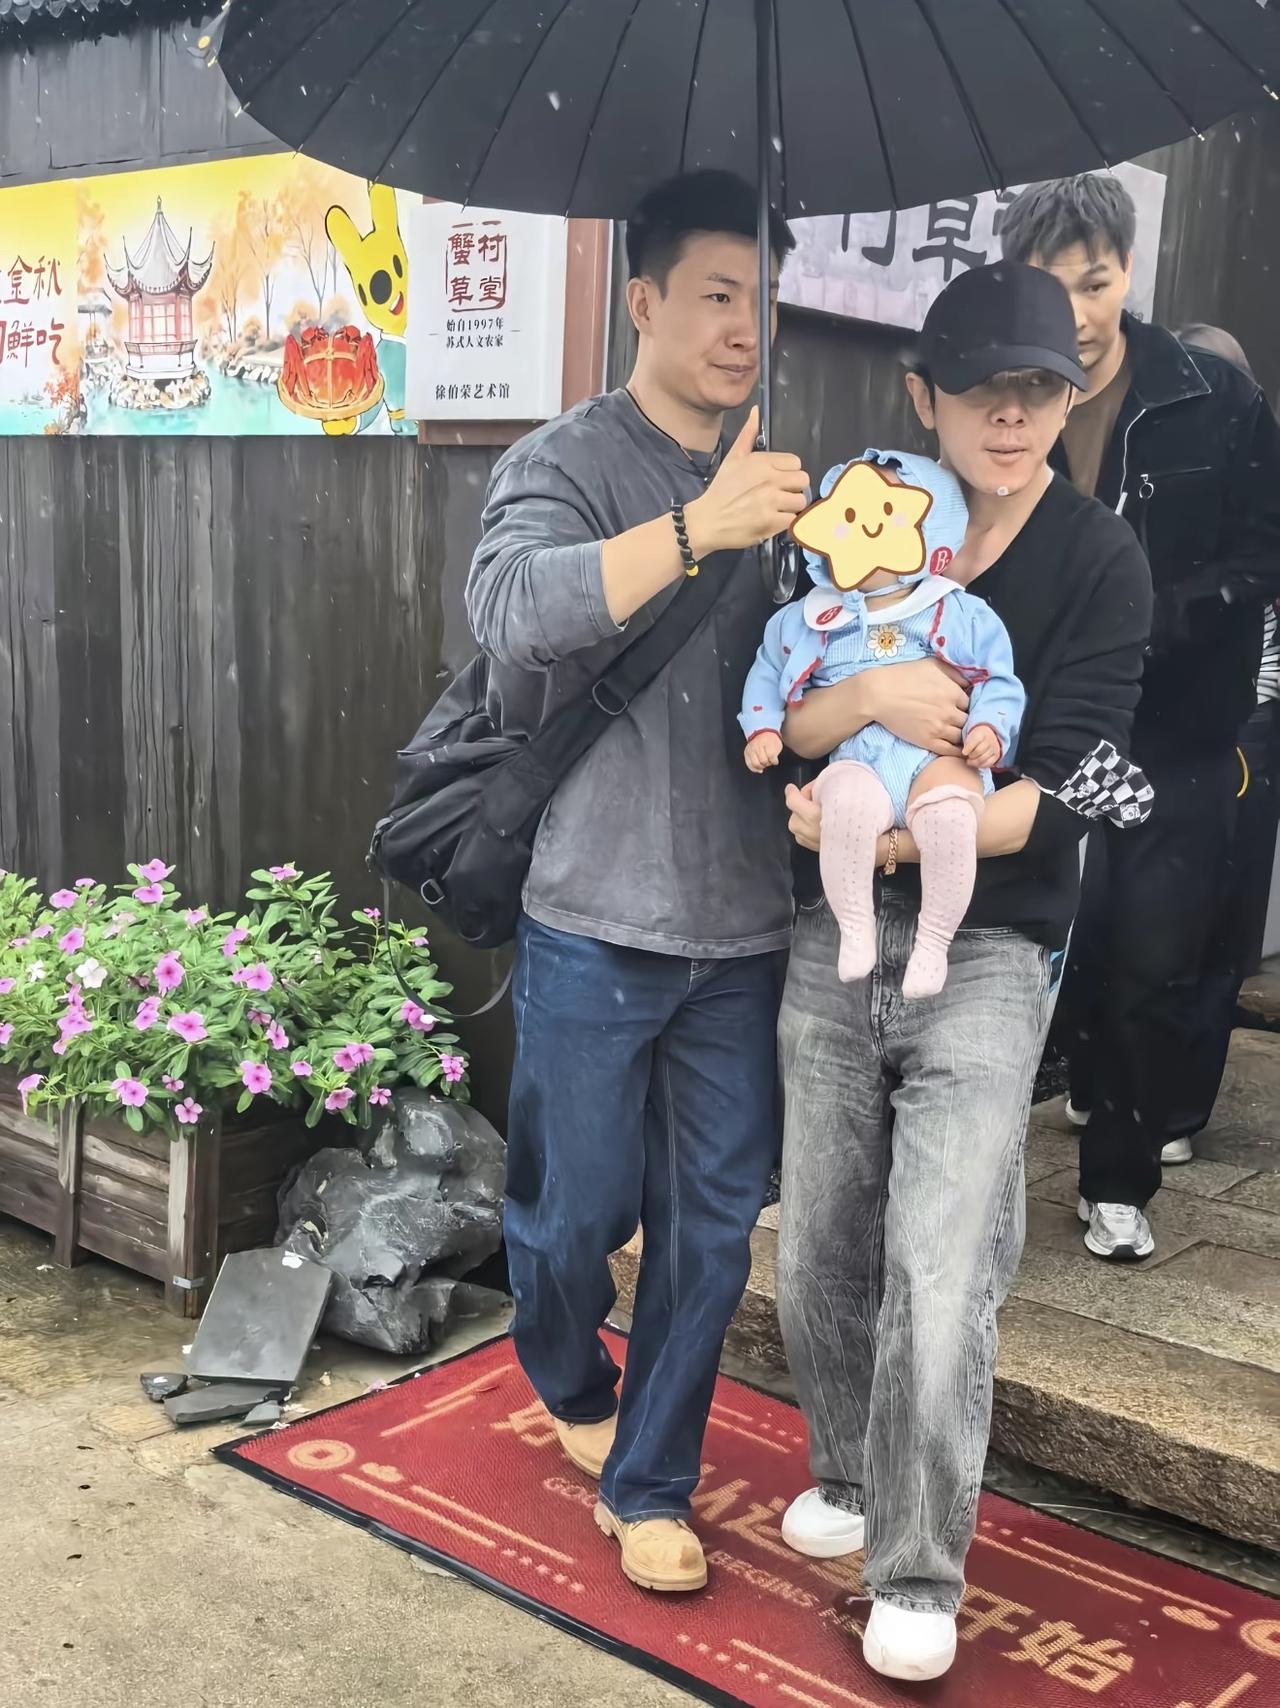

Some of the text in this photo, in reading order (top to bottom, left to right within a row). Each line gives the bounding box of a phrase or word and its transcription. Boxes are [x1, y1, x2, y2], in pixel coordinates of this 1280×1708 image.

[447, 317, 503, 332] 始自1997年
[446, 334, 503, 348] 苏式人文农家
[435, 383, 510, 400] 徐伯荣艺术馆
